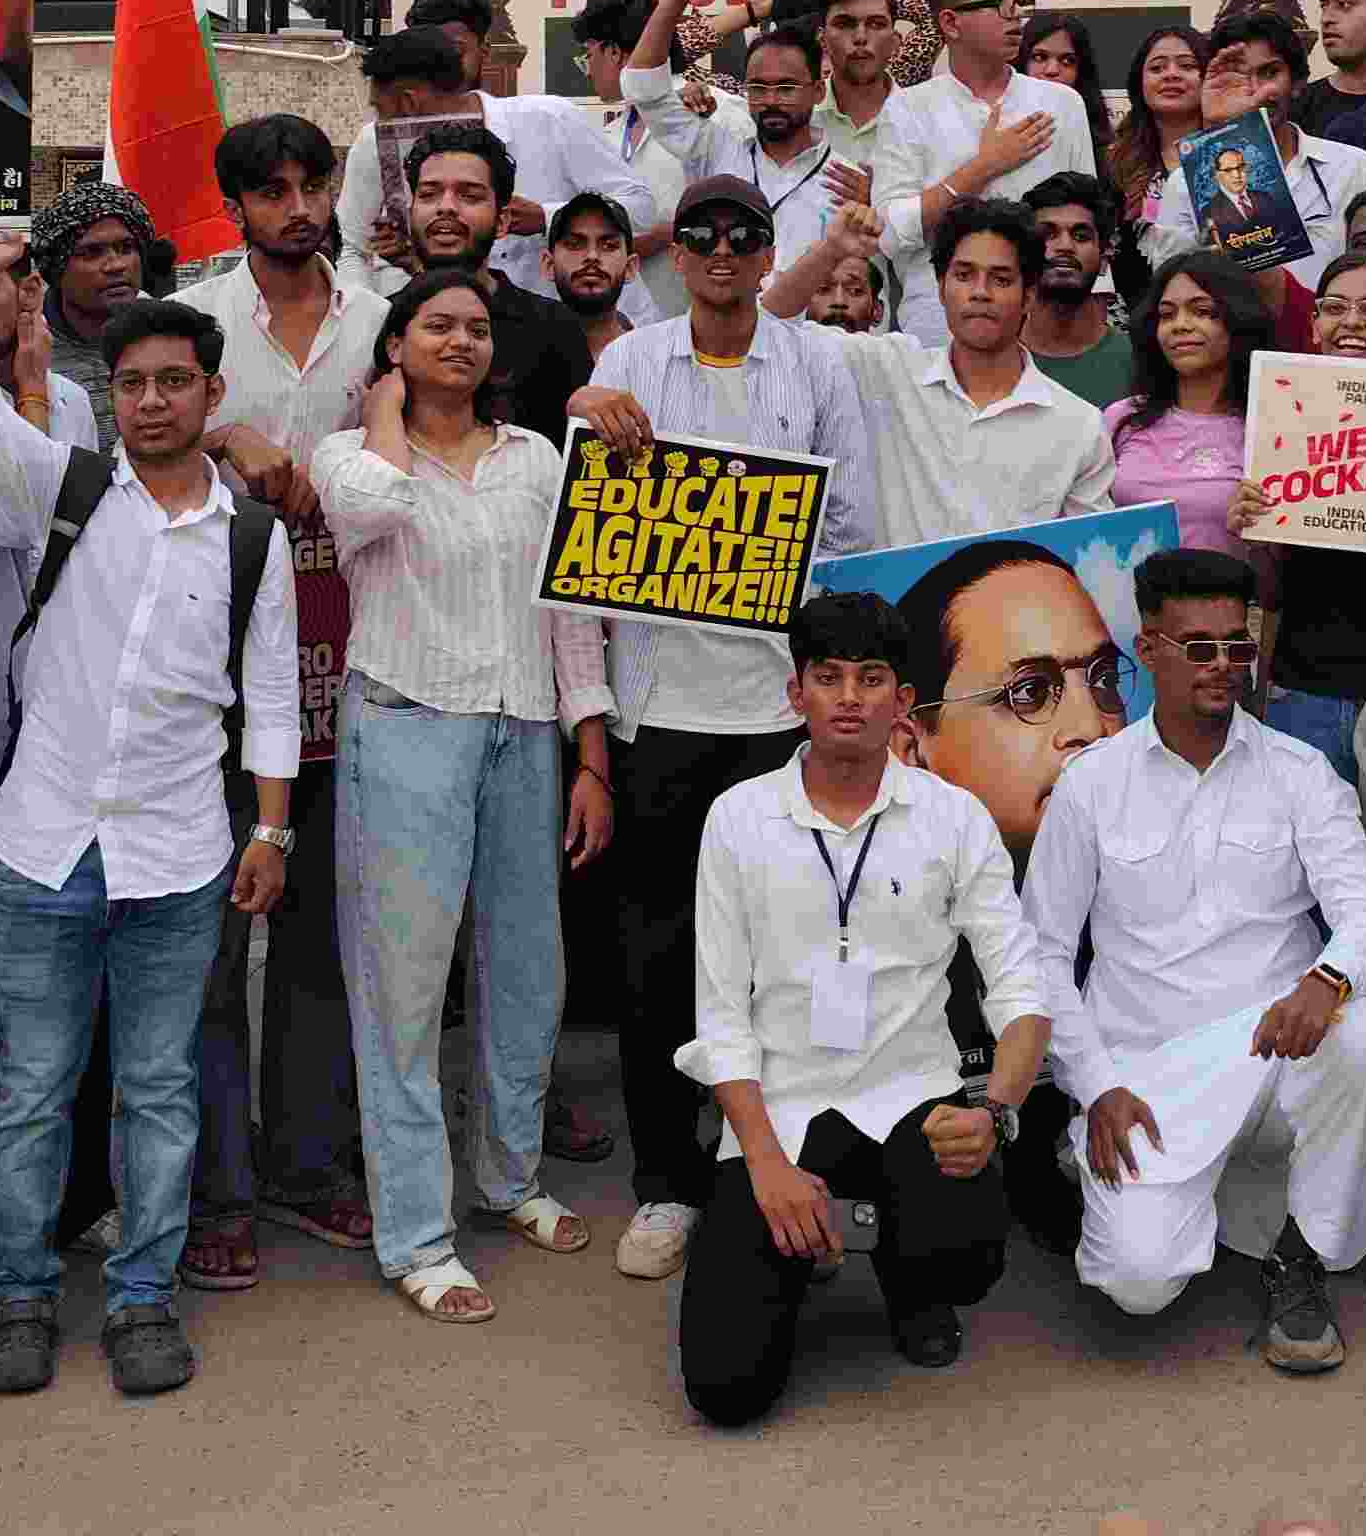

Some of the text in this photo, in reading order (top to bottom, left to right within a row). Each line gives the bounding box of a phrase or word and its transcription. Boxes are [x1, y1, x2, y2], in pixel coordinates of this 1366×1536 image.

[569, 475, 819, 541] EDUCATE!
[1326, 506, 1365, 521] INDIA
[554, 510, 804, 577] AGITATE!!
[550, 570, 797, 625] ORGANIZE!!!
